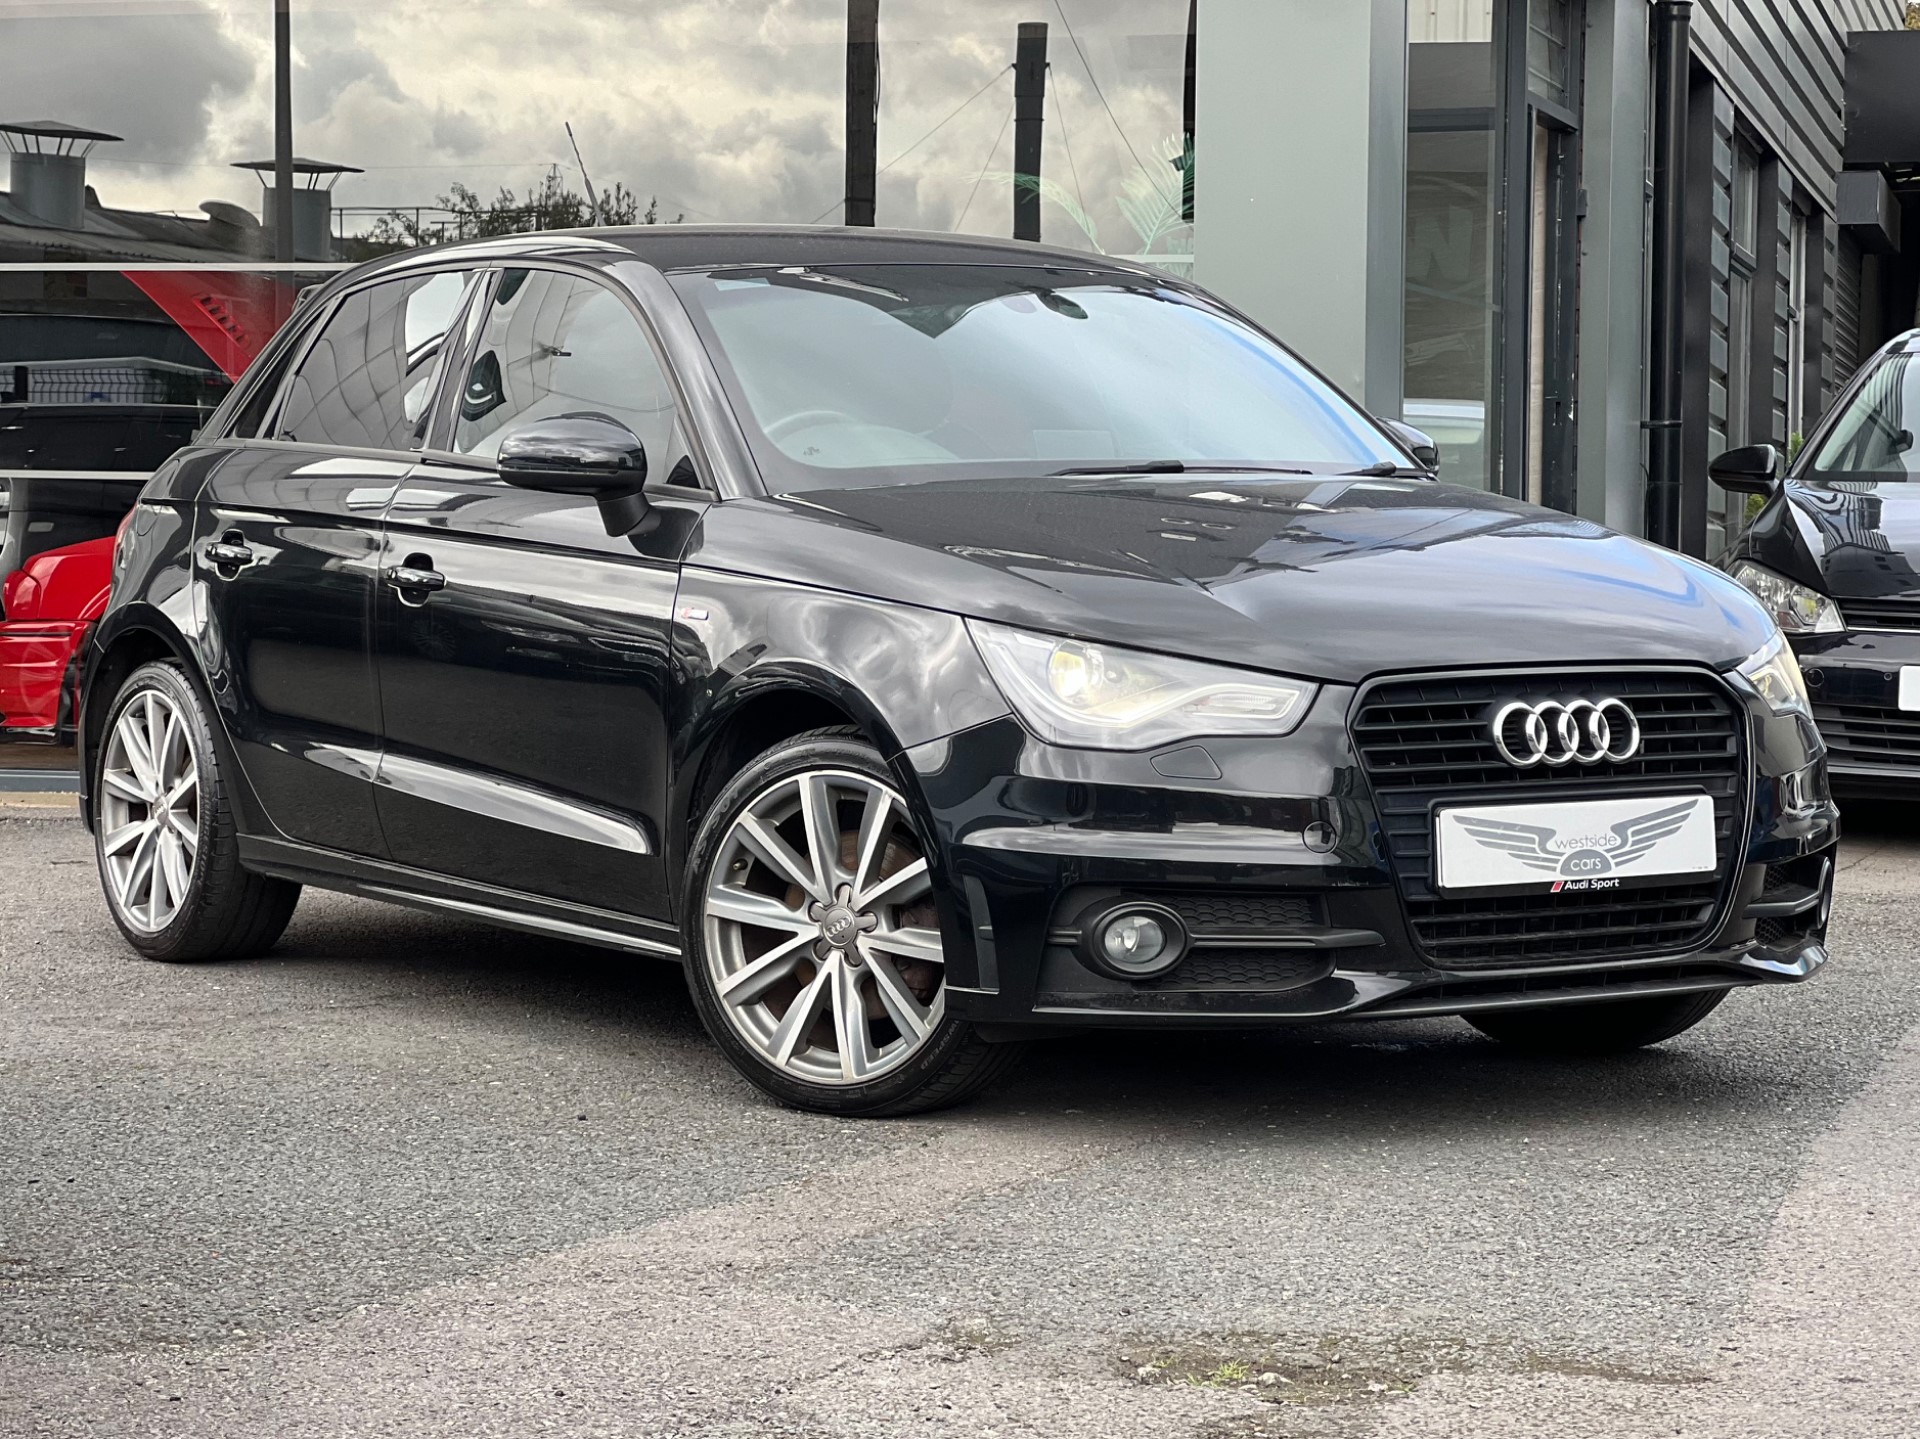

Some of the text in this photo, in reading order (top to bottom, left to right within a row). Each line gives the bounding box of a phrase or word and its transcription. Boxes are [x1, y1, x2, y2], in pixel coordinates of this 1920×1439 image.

[1555, 833, 1618, 850] westside
[1570, 858, 1602, 871] cars
[1564, 879, 1620, 891] Audi Sport
